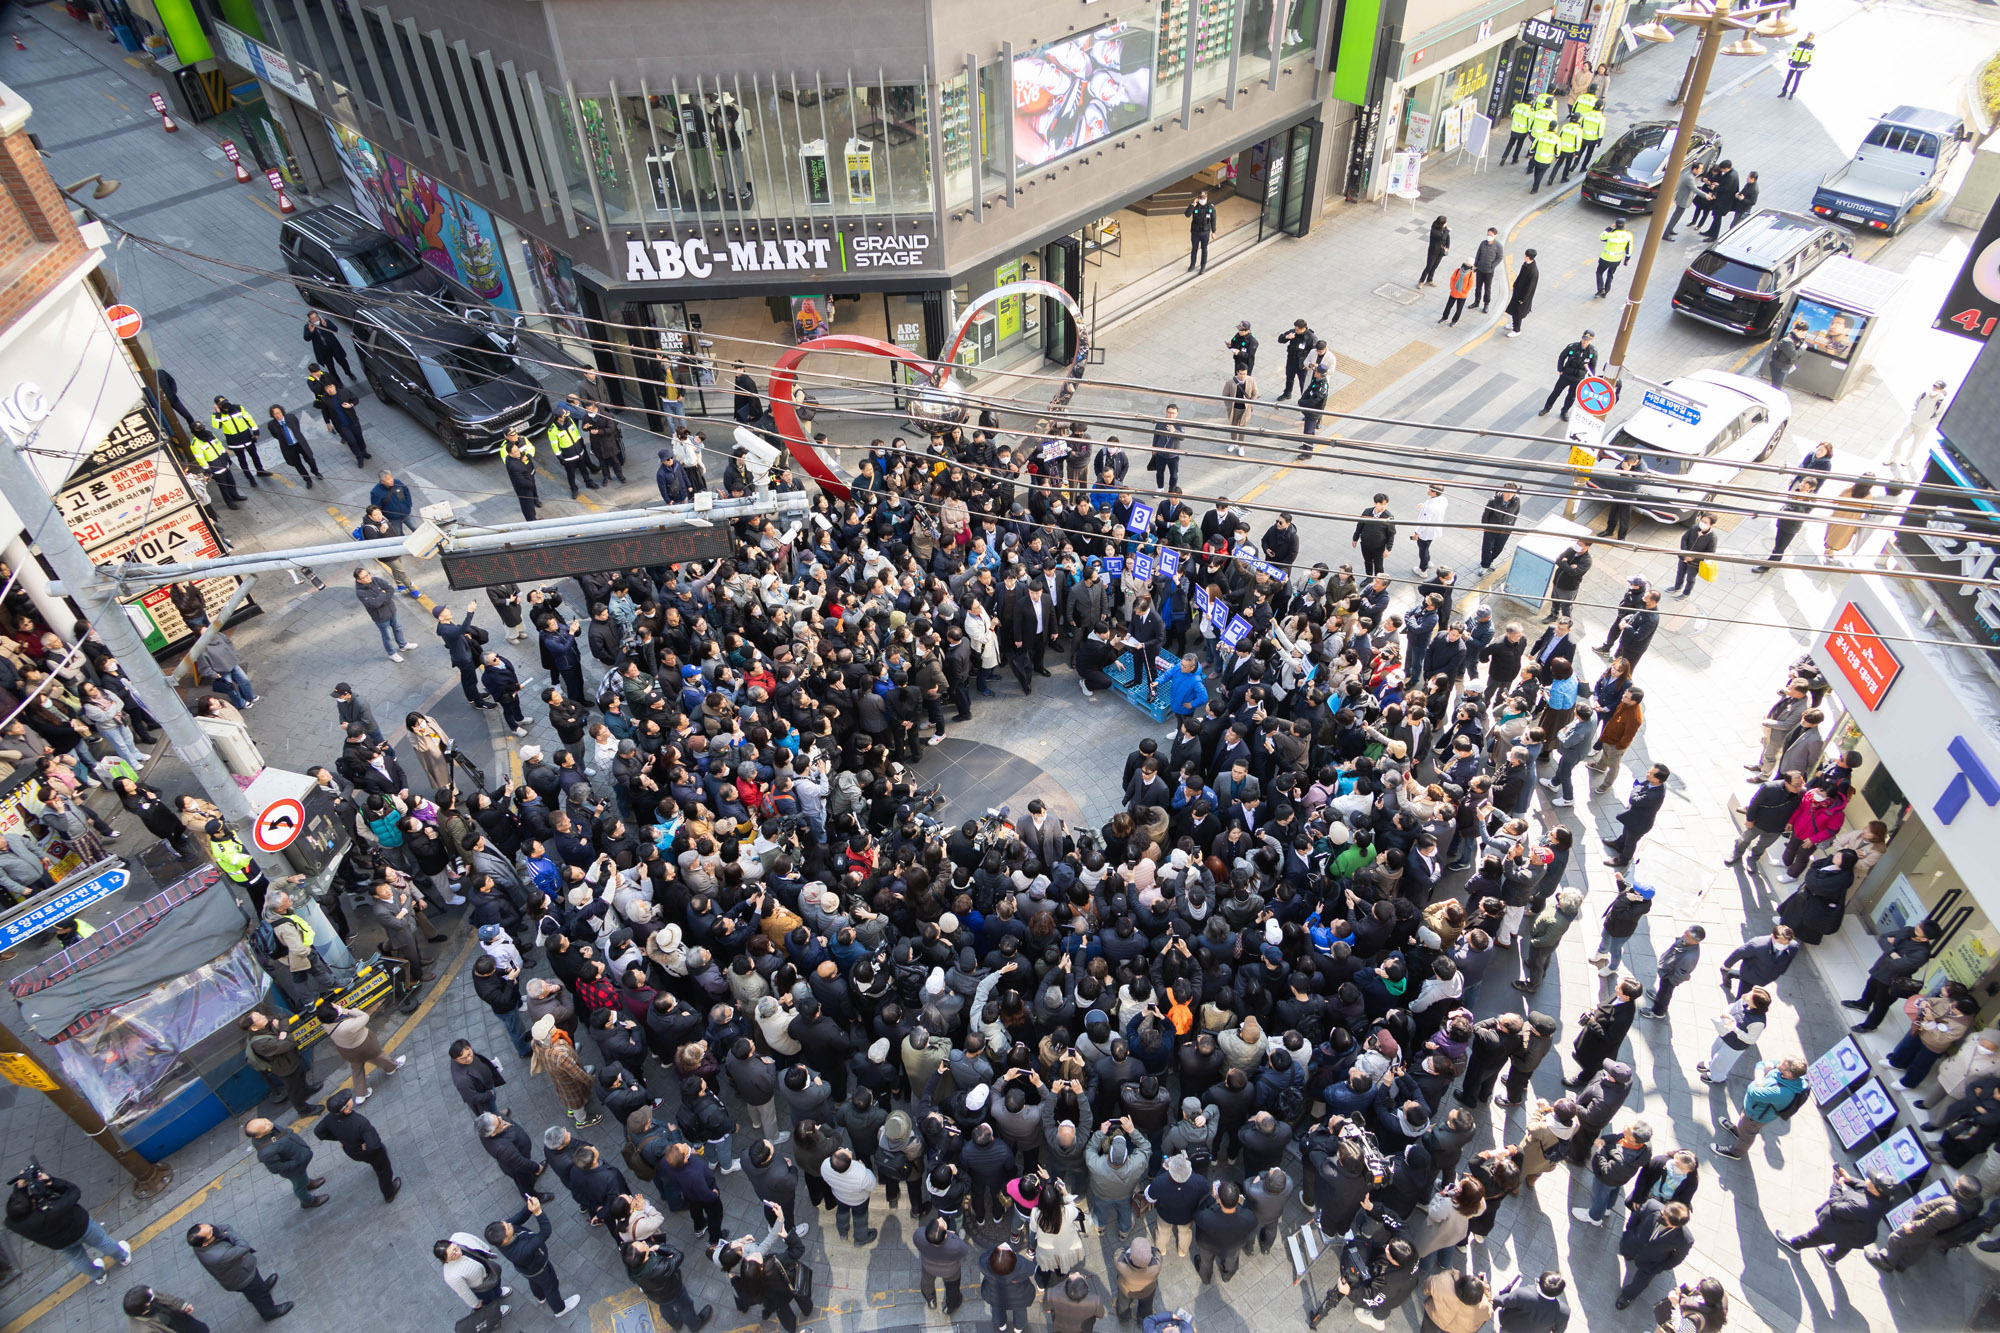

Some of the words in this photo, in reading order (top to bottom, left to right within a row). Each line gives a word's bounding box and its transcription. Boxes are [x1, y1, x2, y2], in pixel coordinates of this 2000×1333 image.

[1836, 199, 1874, 214] HYUNDAI
[852, 234, 929, 251] GRAND
[626, 238, 831, 281] ABC-MART
[854, 250, 923, 267] STAGE
[660, 332, 682, 342] ABC
[897, 323, 919, 334] ABC
[107, 432, 155, 460] 818-6888
[1135, 511, 1145, 523] 3
[1137, 561, 1148, 576] 은
[1164, 555, 1176, 572] 너
[1230, 623, 1246, 641] 다
[1835, 634, 1850, 655] 공식
[1846, 650, 1861, 670] 인증
[1859, 666, 1879, 695] 대리점
[107, 874, 122, 885] 12
[10, 911, 66, 943] Jungang-daero
[64, 887, 110, 917] 692beon-gil
